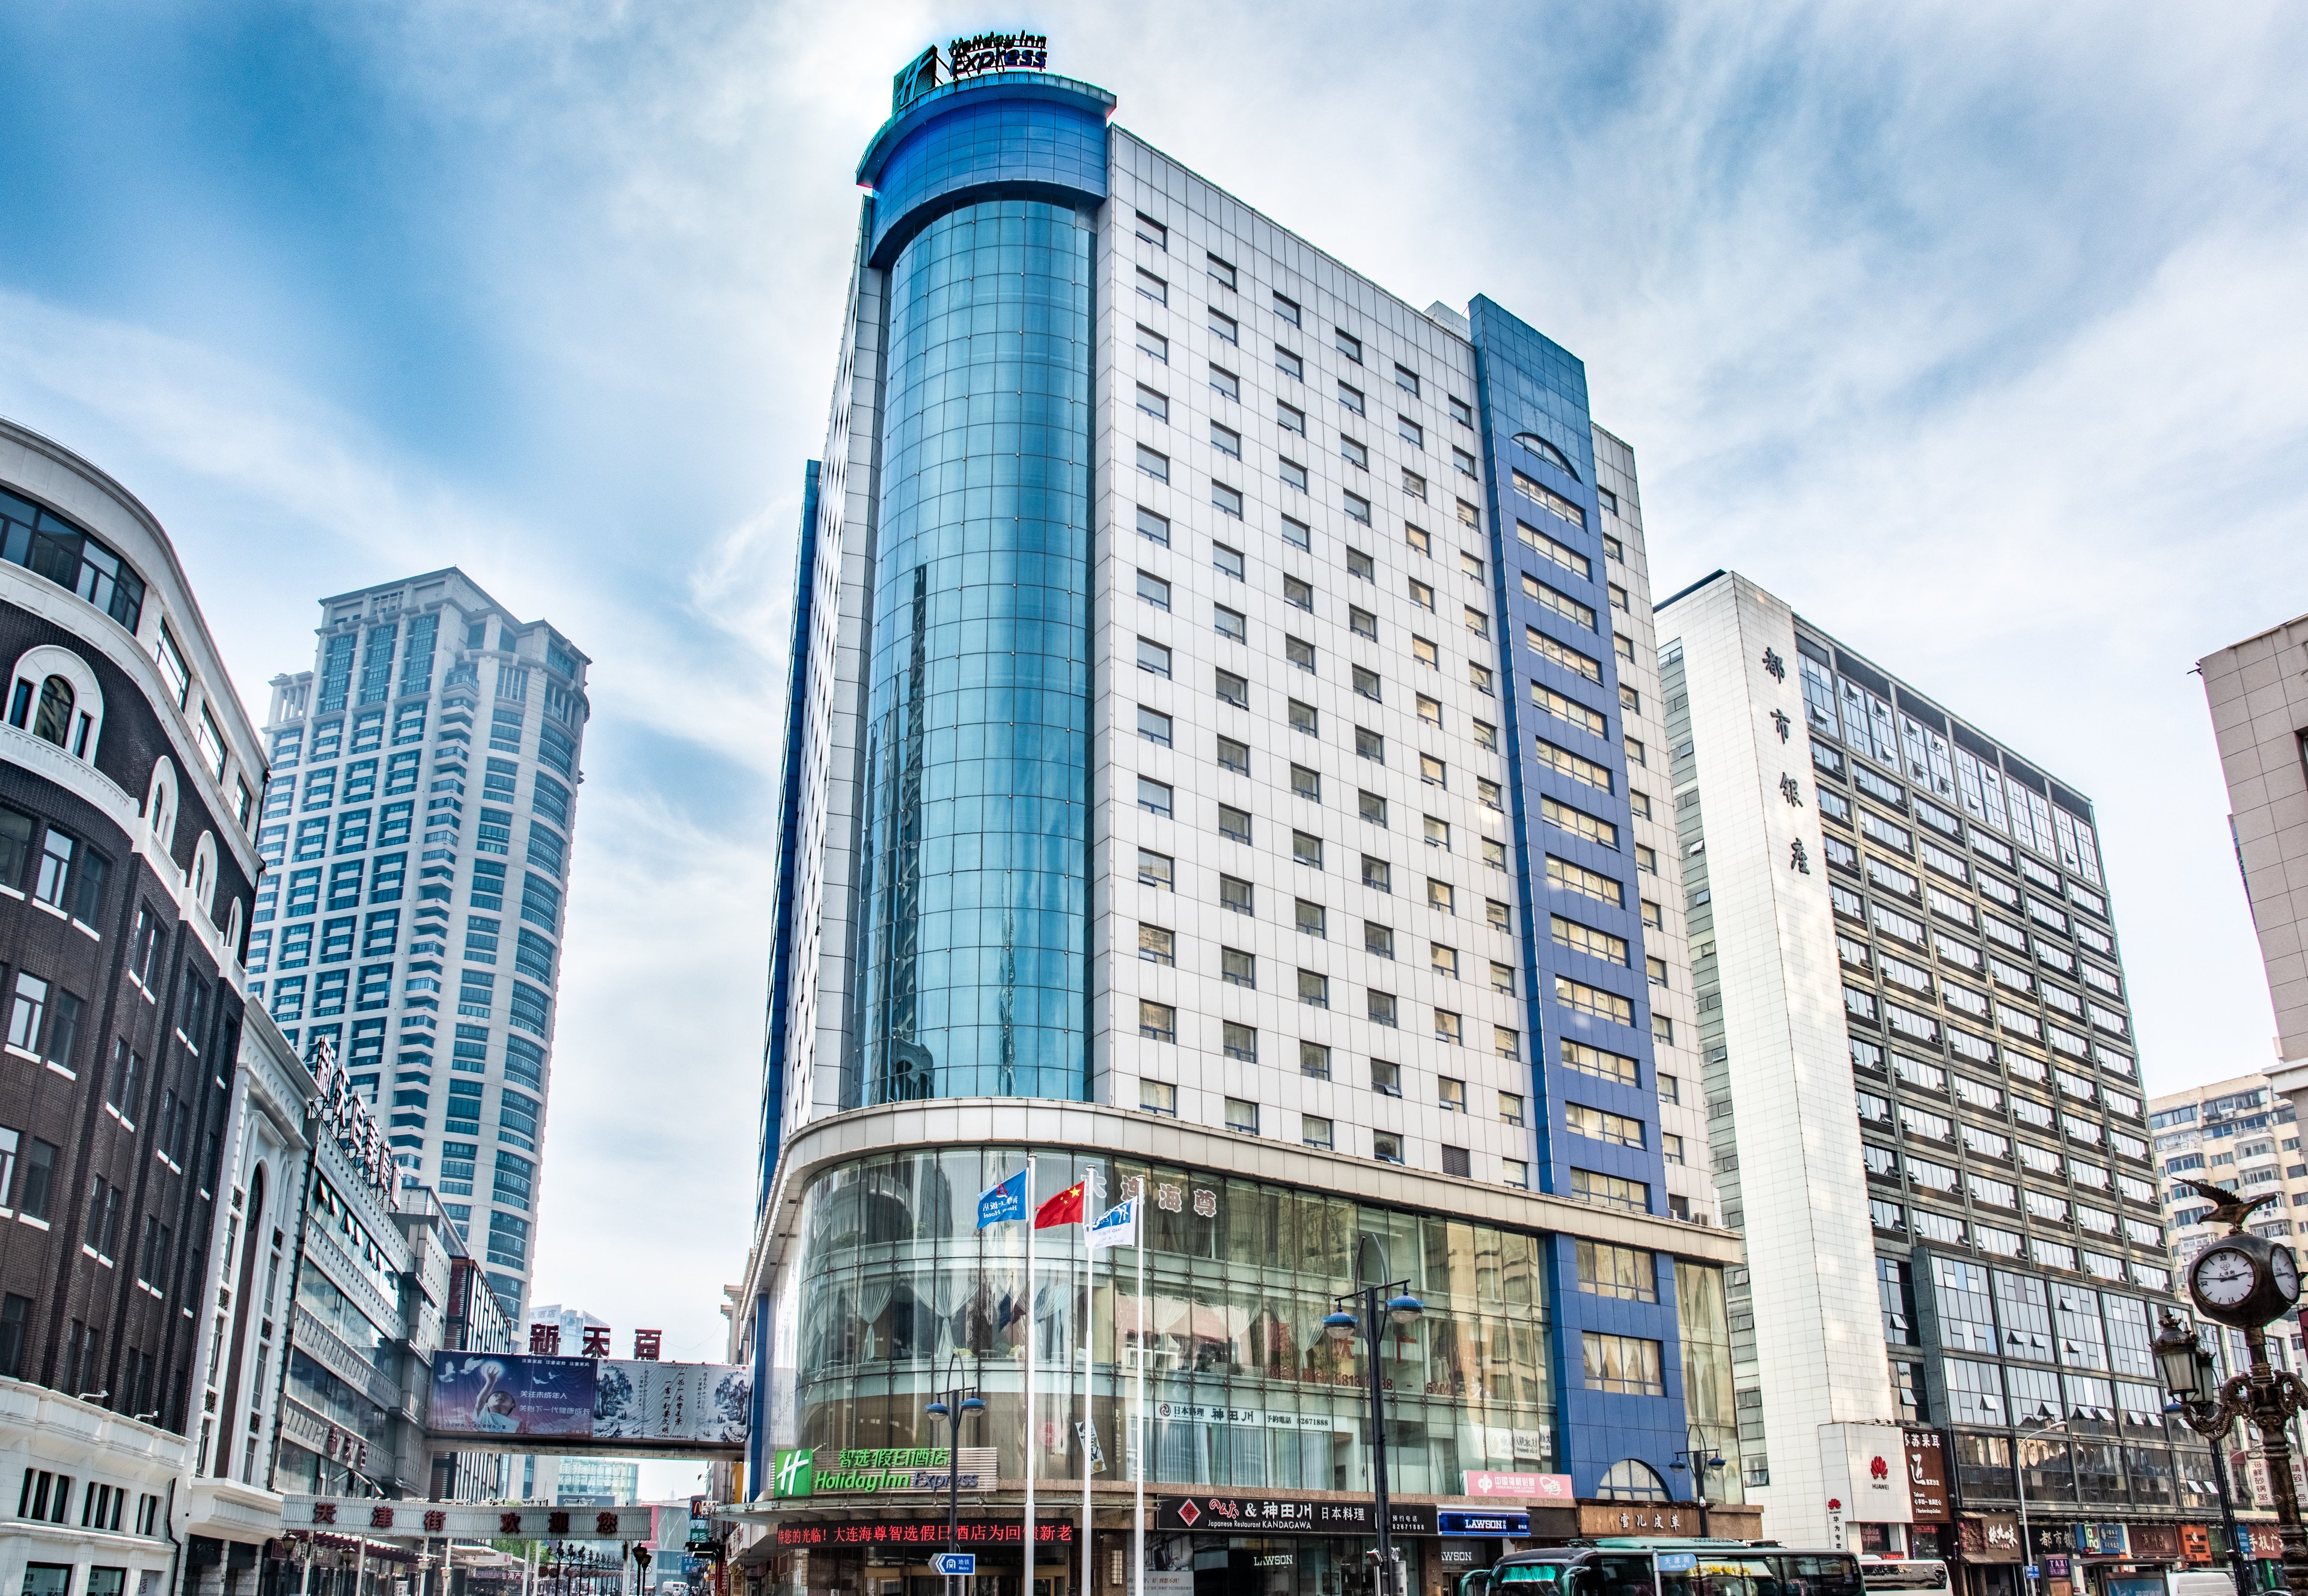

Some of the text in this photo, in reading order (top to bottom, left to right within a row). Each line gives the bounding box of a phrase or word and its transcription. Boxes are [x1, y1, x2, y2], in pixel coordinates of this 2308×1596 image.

[1018, 30, 1045, 48] Inn
[950, 49, 1047, 76] Express
[1762, 646, 1810, 875] 都市银座
[529, 1324, 662, 1359] 新天百
[521, 1390, 567, 1400] 关注未成年人
[519, 1405, 590, 1415] 关心下一代健康成长
[838, 1448, 950, 1467] 智选假日酒店
[814, 1470, 878, 1492] Holiday
[879, 1469, 910, 1488] Inn
[2251, 1461, 2268, 1501] 海鲜砂锅粥
[313, 1502, 617, 1534] 天津街 欢迎您
[1245, 1503, 1257, 1517] &
[1262, 1502, 1312, 1520] 神田川
[1321, 1506, 1364, 1521] 日本料理
[1208, 1520, 1232, 1529] Japanese
[1262, 1521, 1311, 1529] KANDAGAWA
[1465, 1520, 1503, 1529] LAWSON
[1620, 1513, 1680, 1531] 雪儿皮草
[2248, 1533, 2284, 1552] 手机广
[1254, 1555, 1293, 1566] LAWSON
[1664, 1556, 1690, 1565] 天津街
